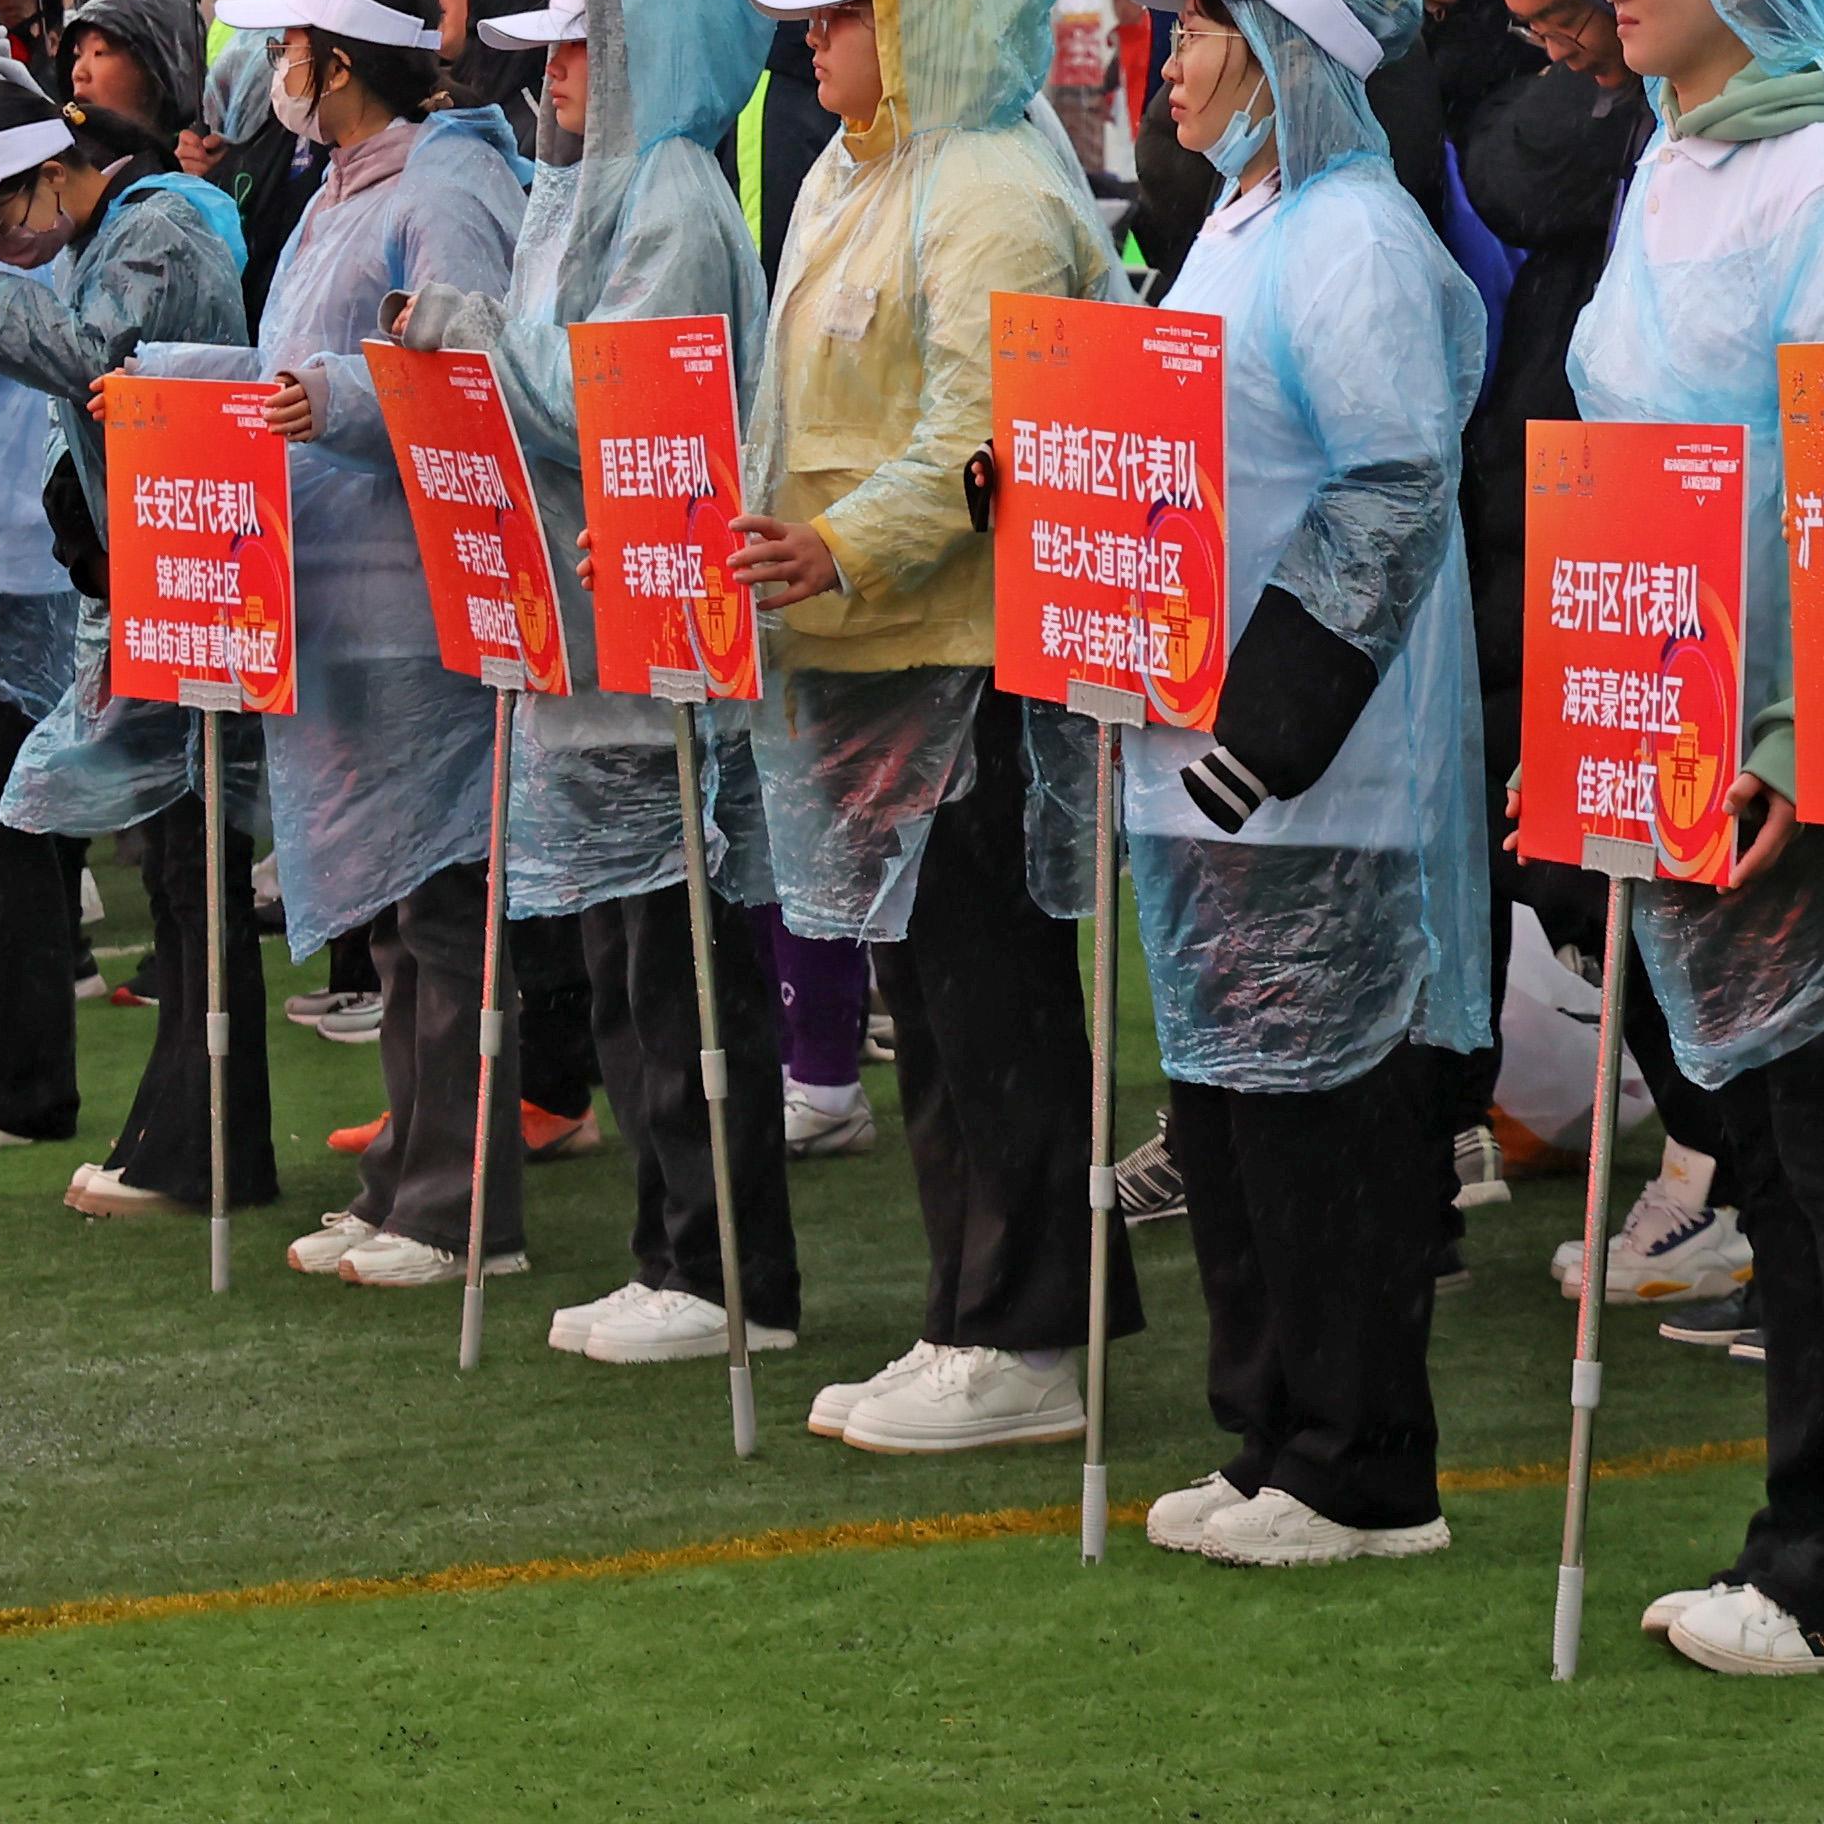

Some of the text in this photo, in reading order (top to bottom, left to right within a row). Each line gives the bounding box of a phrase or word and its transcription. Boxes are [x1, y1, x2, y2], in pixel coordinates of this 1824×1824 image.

[409, 443, 514, 510] 鄠邑区代表队
[600, 434, 714, 499] 周至县代表队
[1012, 419, 1203, 511] 西咸新区代表队
[133, 474, 261, 537] 长安区代表队
[156, 555, 242, 605] 锦湖街社区
[453, 528, 510, 579] 丰京社区
[622, 542, 707, 599] 辛家寨社区
[1031, 519, 1184, 597] 世纪大道南社区
[466, 594, 521, 649] 朝阳社区
[1551, 557, 1702, 641] 经开区代表队
[124, 617, 278, 677] 韦曲街道智慧城社区
[1041, 602, 1172, 682] 秦兴佳苑社区
[1562, 666, 1683, 735] 海荣豪佳社区
[1576, 755, 1658, 827] 佳家社区
